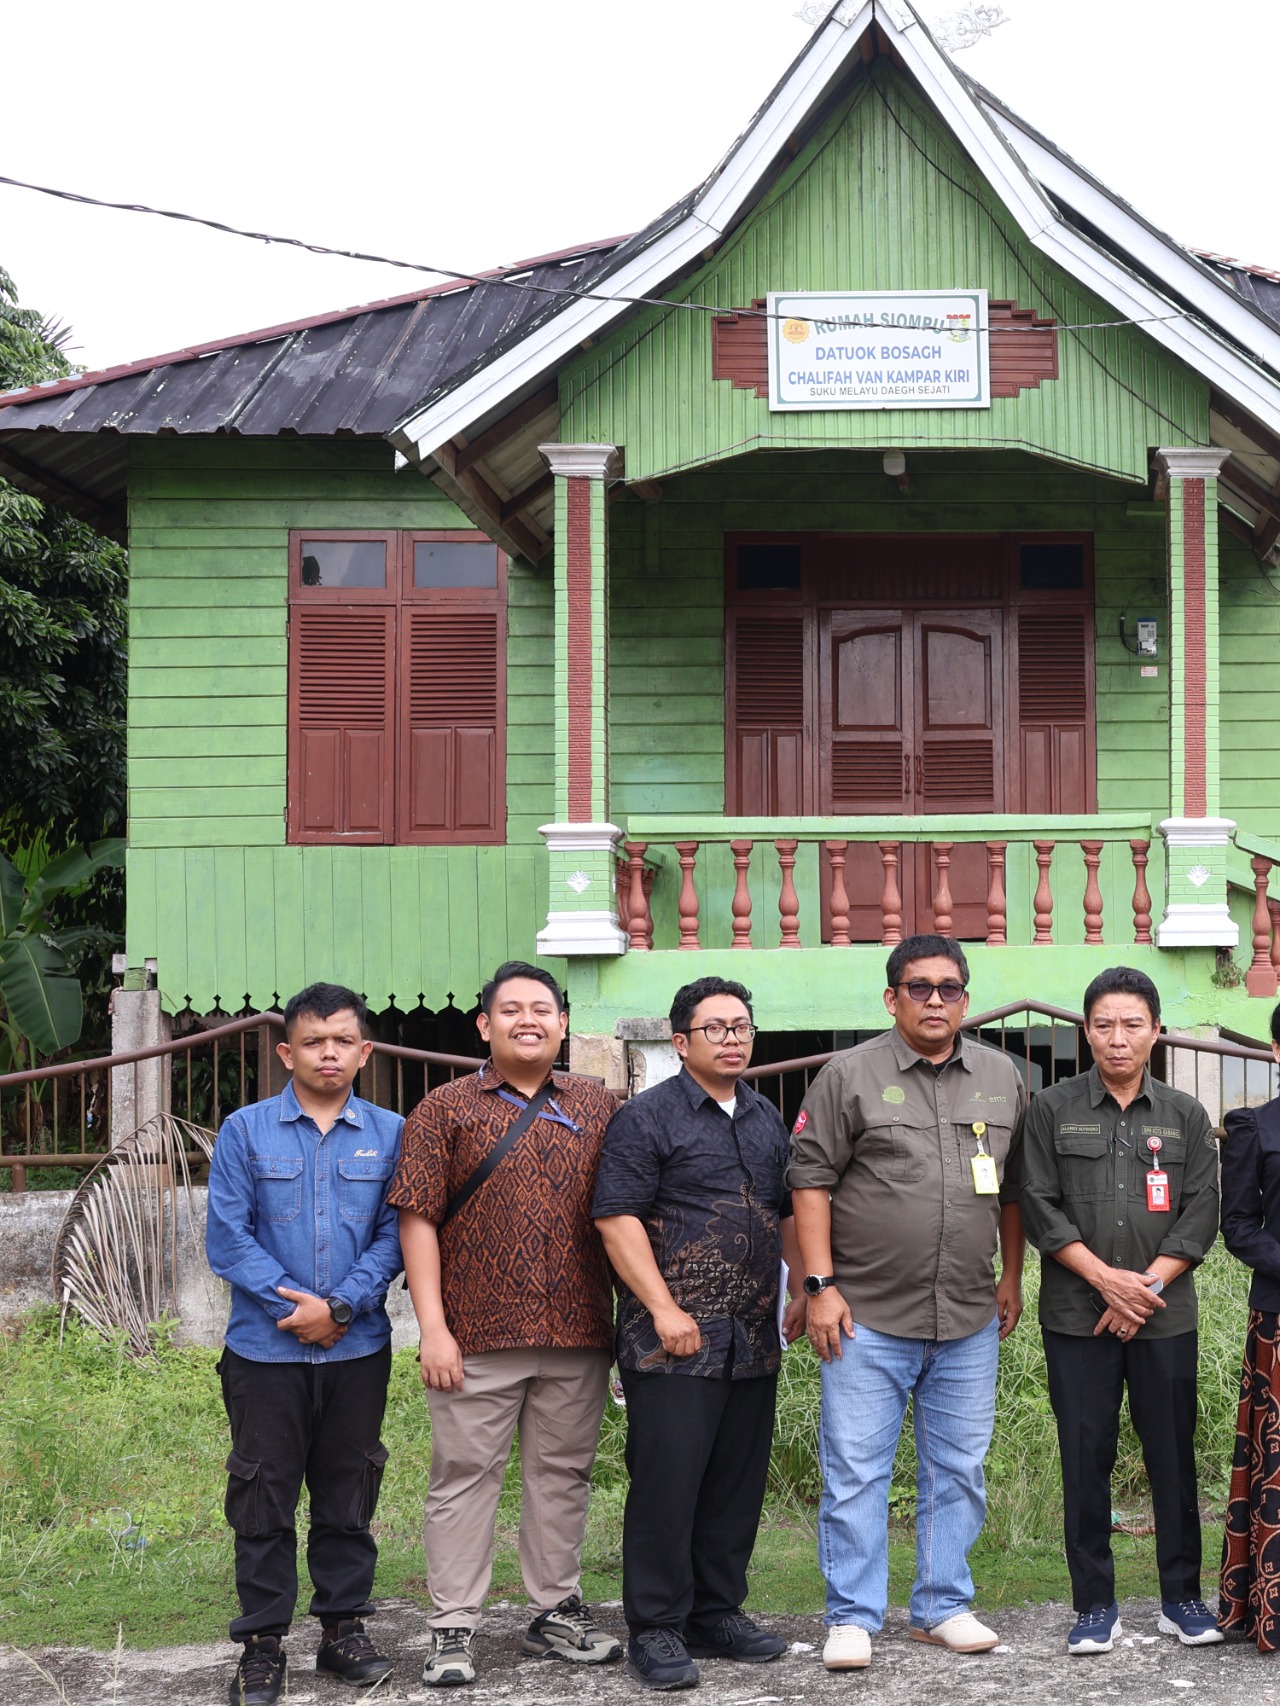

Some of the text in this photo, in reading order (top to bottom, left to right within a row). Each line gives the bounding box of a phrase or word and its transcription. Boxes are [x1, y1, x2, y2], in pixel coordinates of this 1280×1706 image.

[814, 312, 946, 335] RUMAH SIOMPU
[815, 345, 942, 360] DATUOK BOSAGH
[788, 369, 970, 385] CHALIFAH VAN KAMPAR KIRI
[810, 385, 950, 396] SUKU MELAYU DAEGH SEJATI
